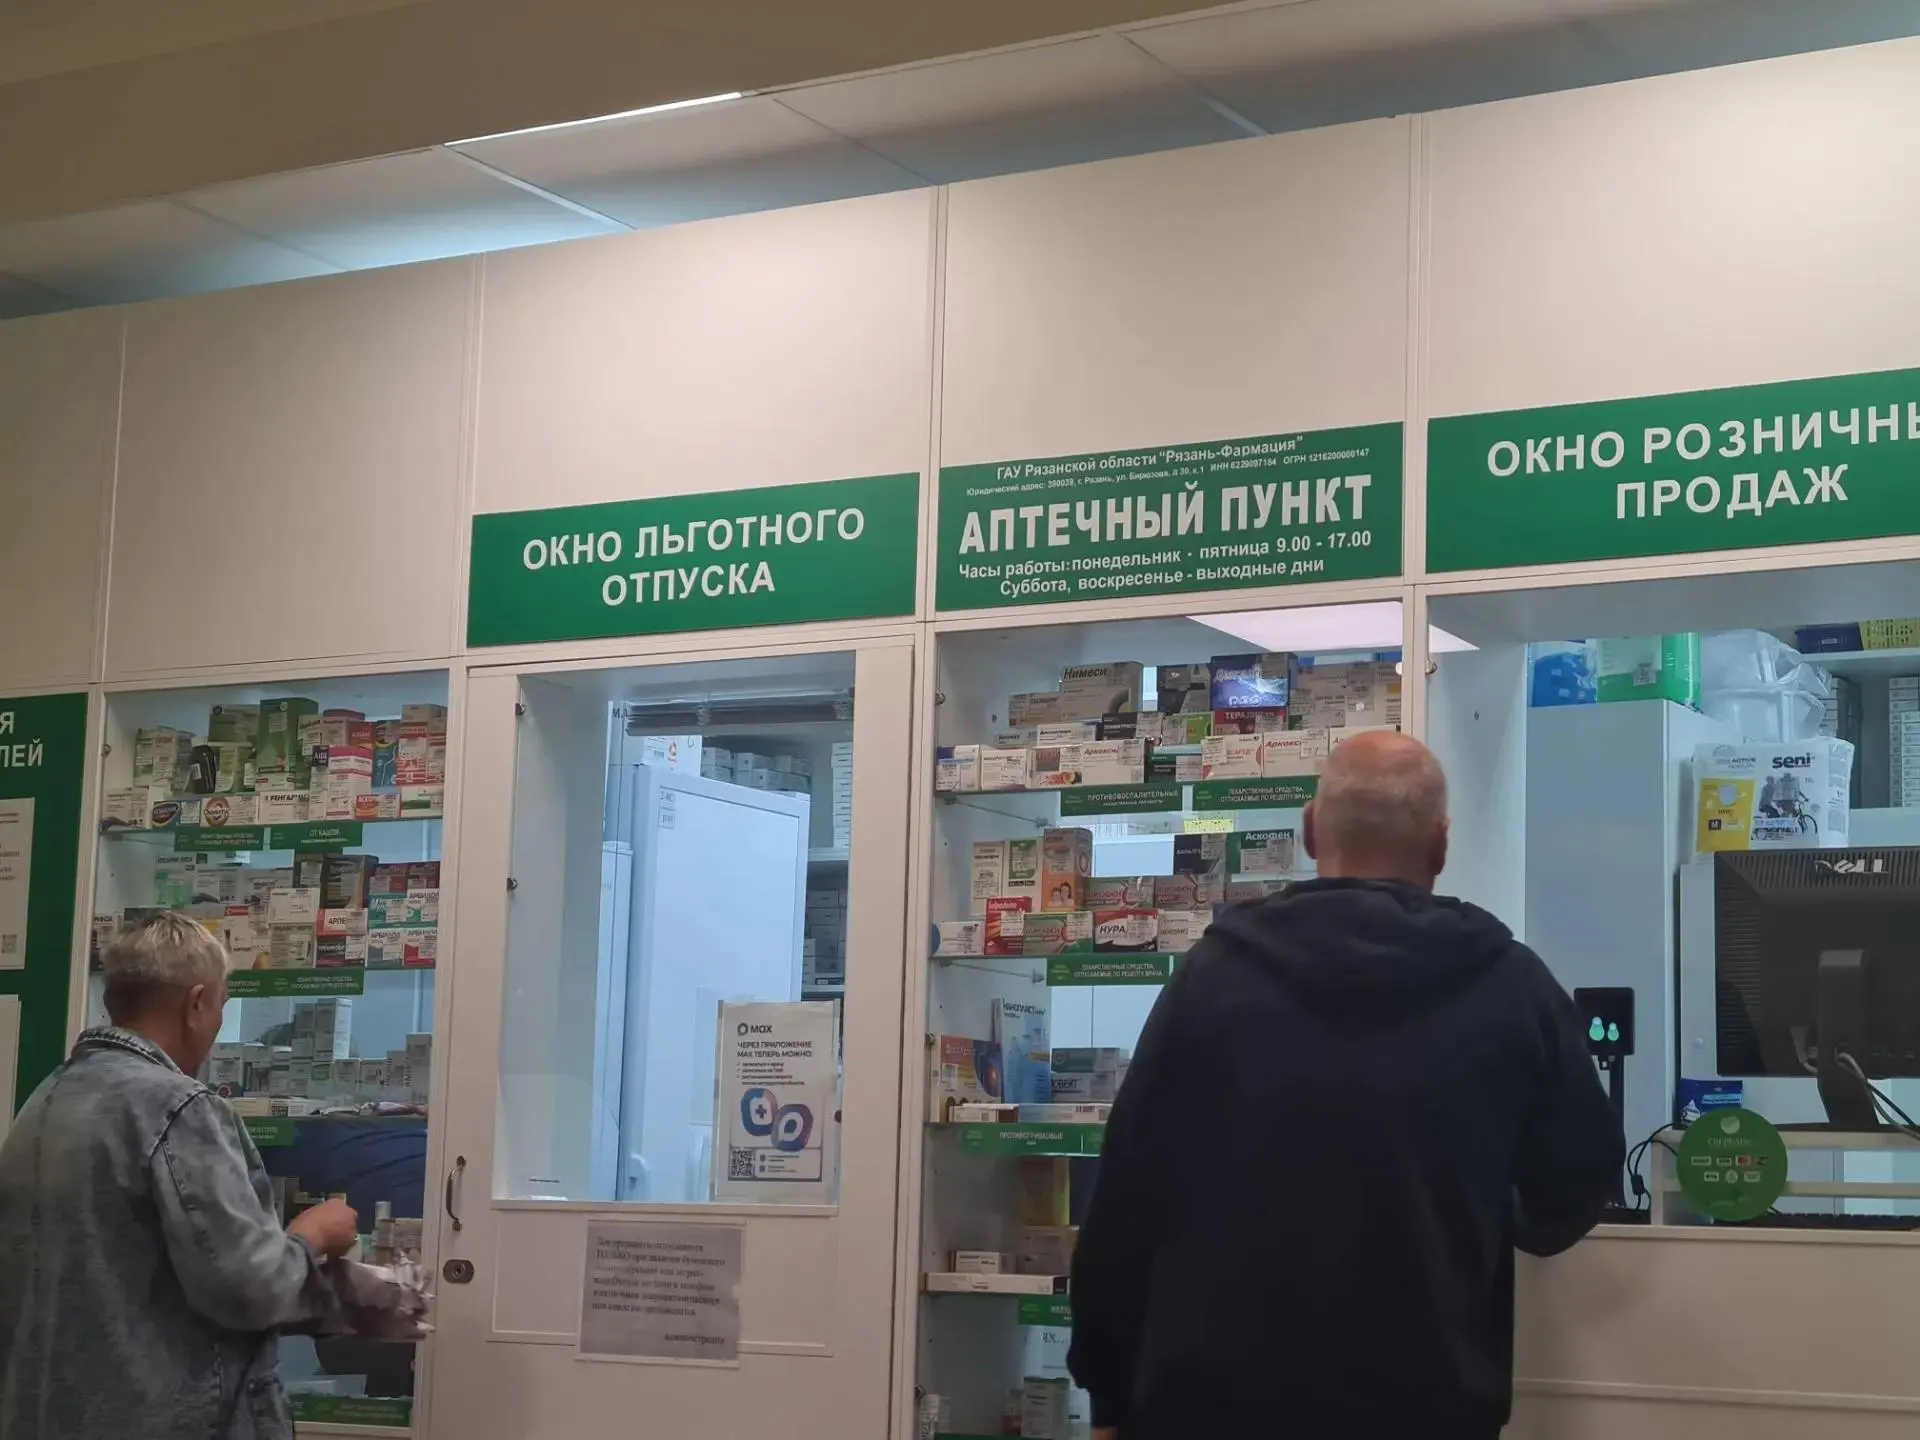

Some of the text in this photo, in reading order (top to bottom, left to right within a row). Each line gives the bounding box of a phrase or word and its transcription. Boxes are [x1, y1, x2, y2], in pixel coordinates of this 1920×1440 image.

[997, 465, 1021, 480] ГАУ
[1025, 457, 1096, 479] Рязанской
[1100, 453, 1158, 470] области
[1210, 461, 1229, 472] ИНН
[1283, 453, 1307, 465] ОГРН
[1487, 432, 1625, 477] ОКНО
[959, 474, 1371, 554] АПТЕЧНЫЙ ПУНКТ
[1617, 464, 1849, 519] ПРОДАЖ
[523, 507, 864, 570] ОКНО ЛЬГОТНОГО
[959, 564, 1000, 578] Часы
[1200, 541, 1270, 560] пятница
[1276, 535, 1311, 553] 9.00
[1327, 530, 1372, 548] 17.00
[602, 561, 775, 606] ОТПУСКА
[1000, 578, 1071, 598] Суббота,
[1078, 570, 1183, 591] воскресенье
[1196, 561, 1286, 580] выходные
[1290, 558, 1325, 575] дни
[1771, 752, 1811, 769] seni
[1814, 858, 1890, 875] DELL
